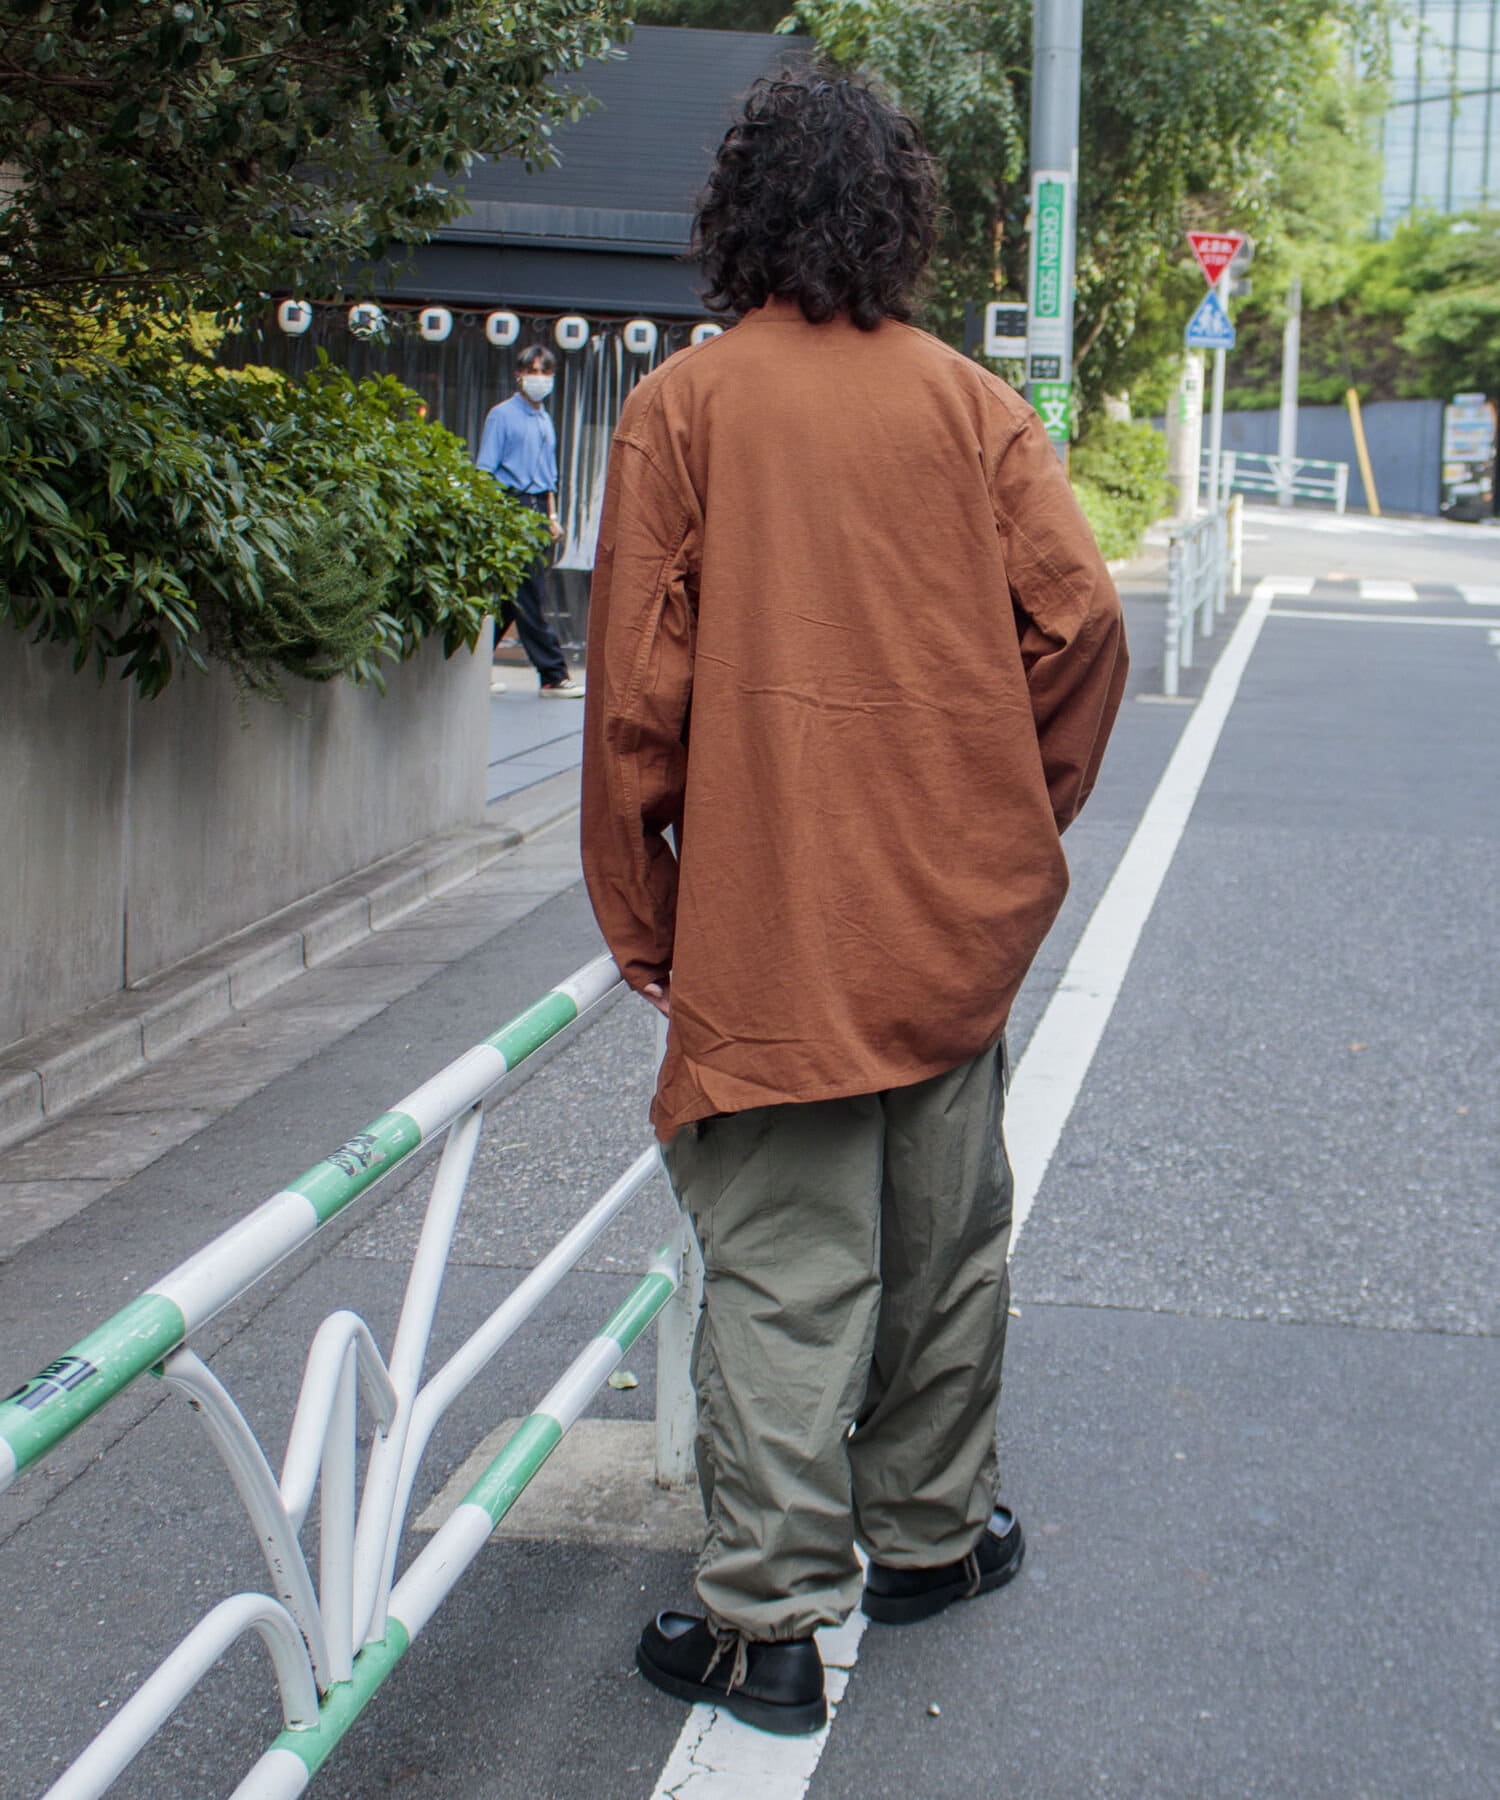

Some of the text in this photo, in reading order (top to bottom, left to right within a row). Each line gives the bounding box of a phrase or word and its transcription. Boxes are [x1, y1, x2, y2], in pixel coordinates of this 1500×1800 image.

[1039, 207, 1060, 267] GREEN
[1038, 268, 1057, 315] SEED
[1040, 400, 1067, 430] 文
